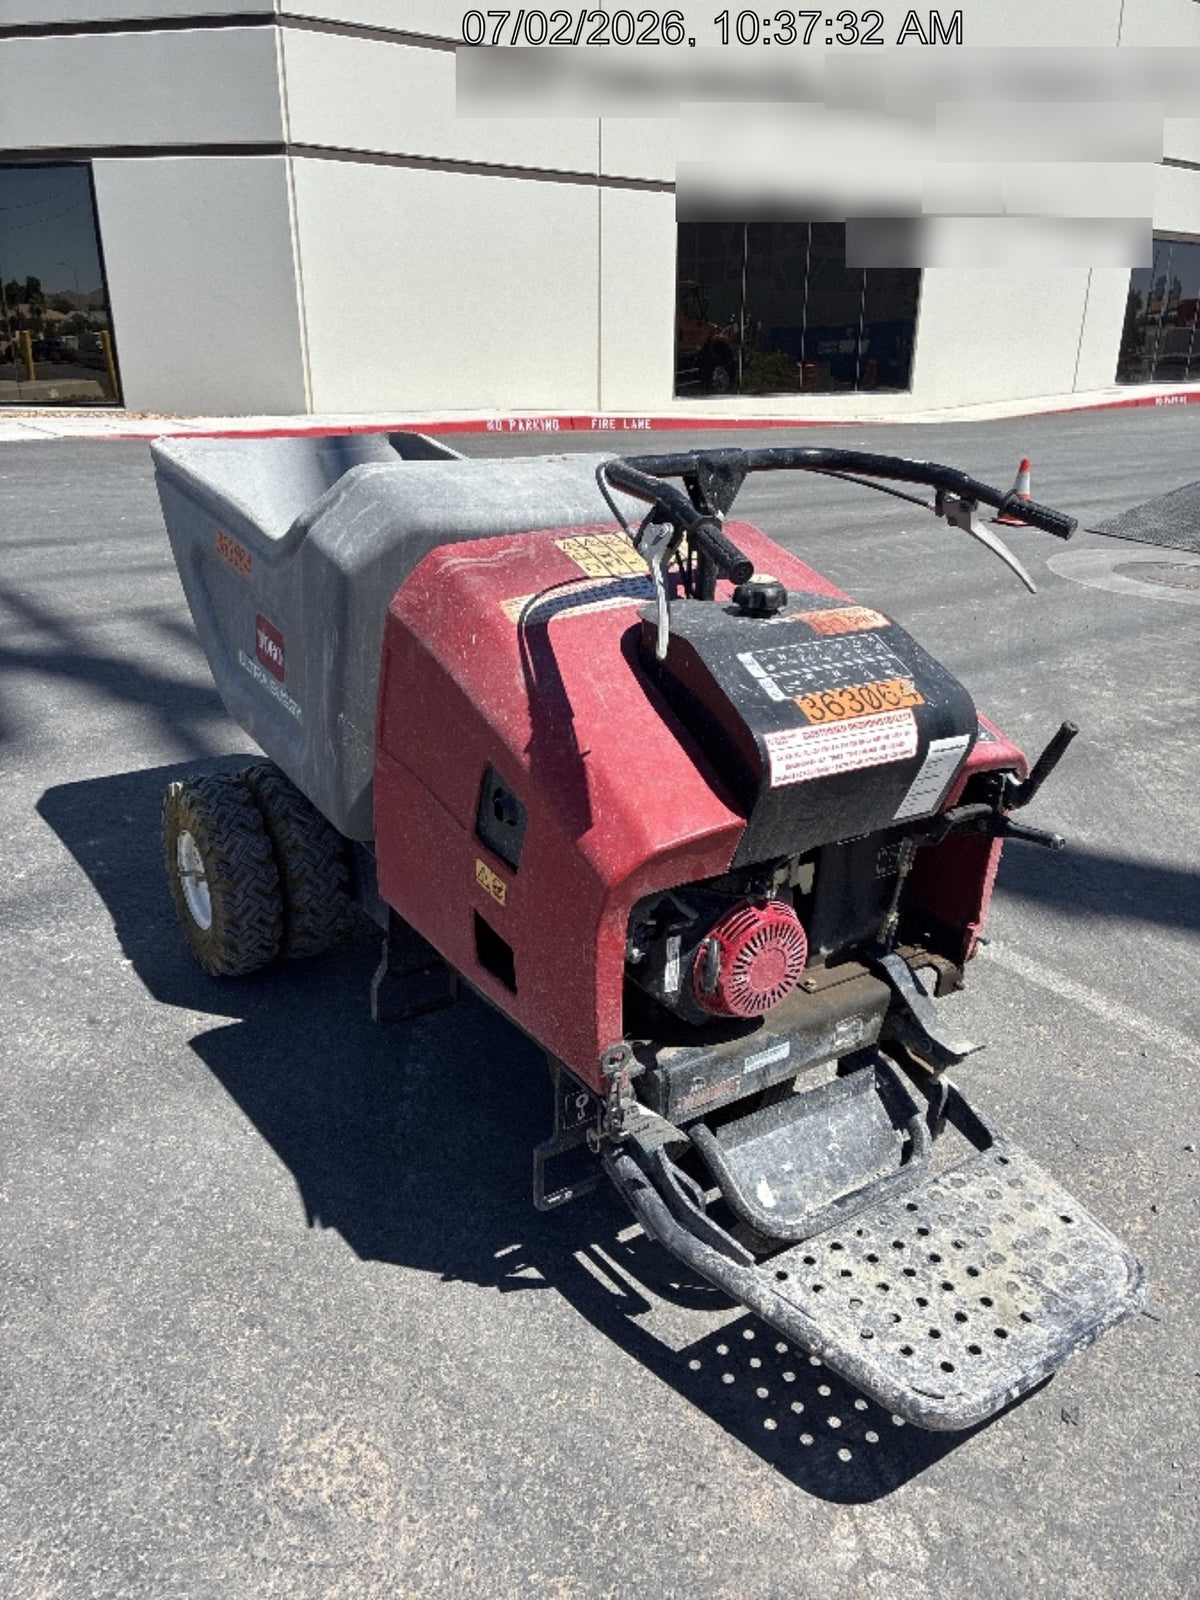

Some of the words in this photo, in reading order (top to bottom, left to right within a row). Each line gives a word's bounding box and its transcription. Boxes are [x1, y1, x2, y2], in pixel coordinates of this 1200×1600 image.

[486, 418, 502, 431] NO
[509, 417, 560, 431] PARKING
[591, 417, 616, 430] FIRE
[623, 417, 652, 430] LANE
